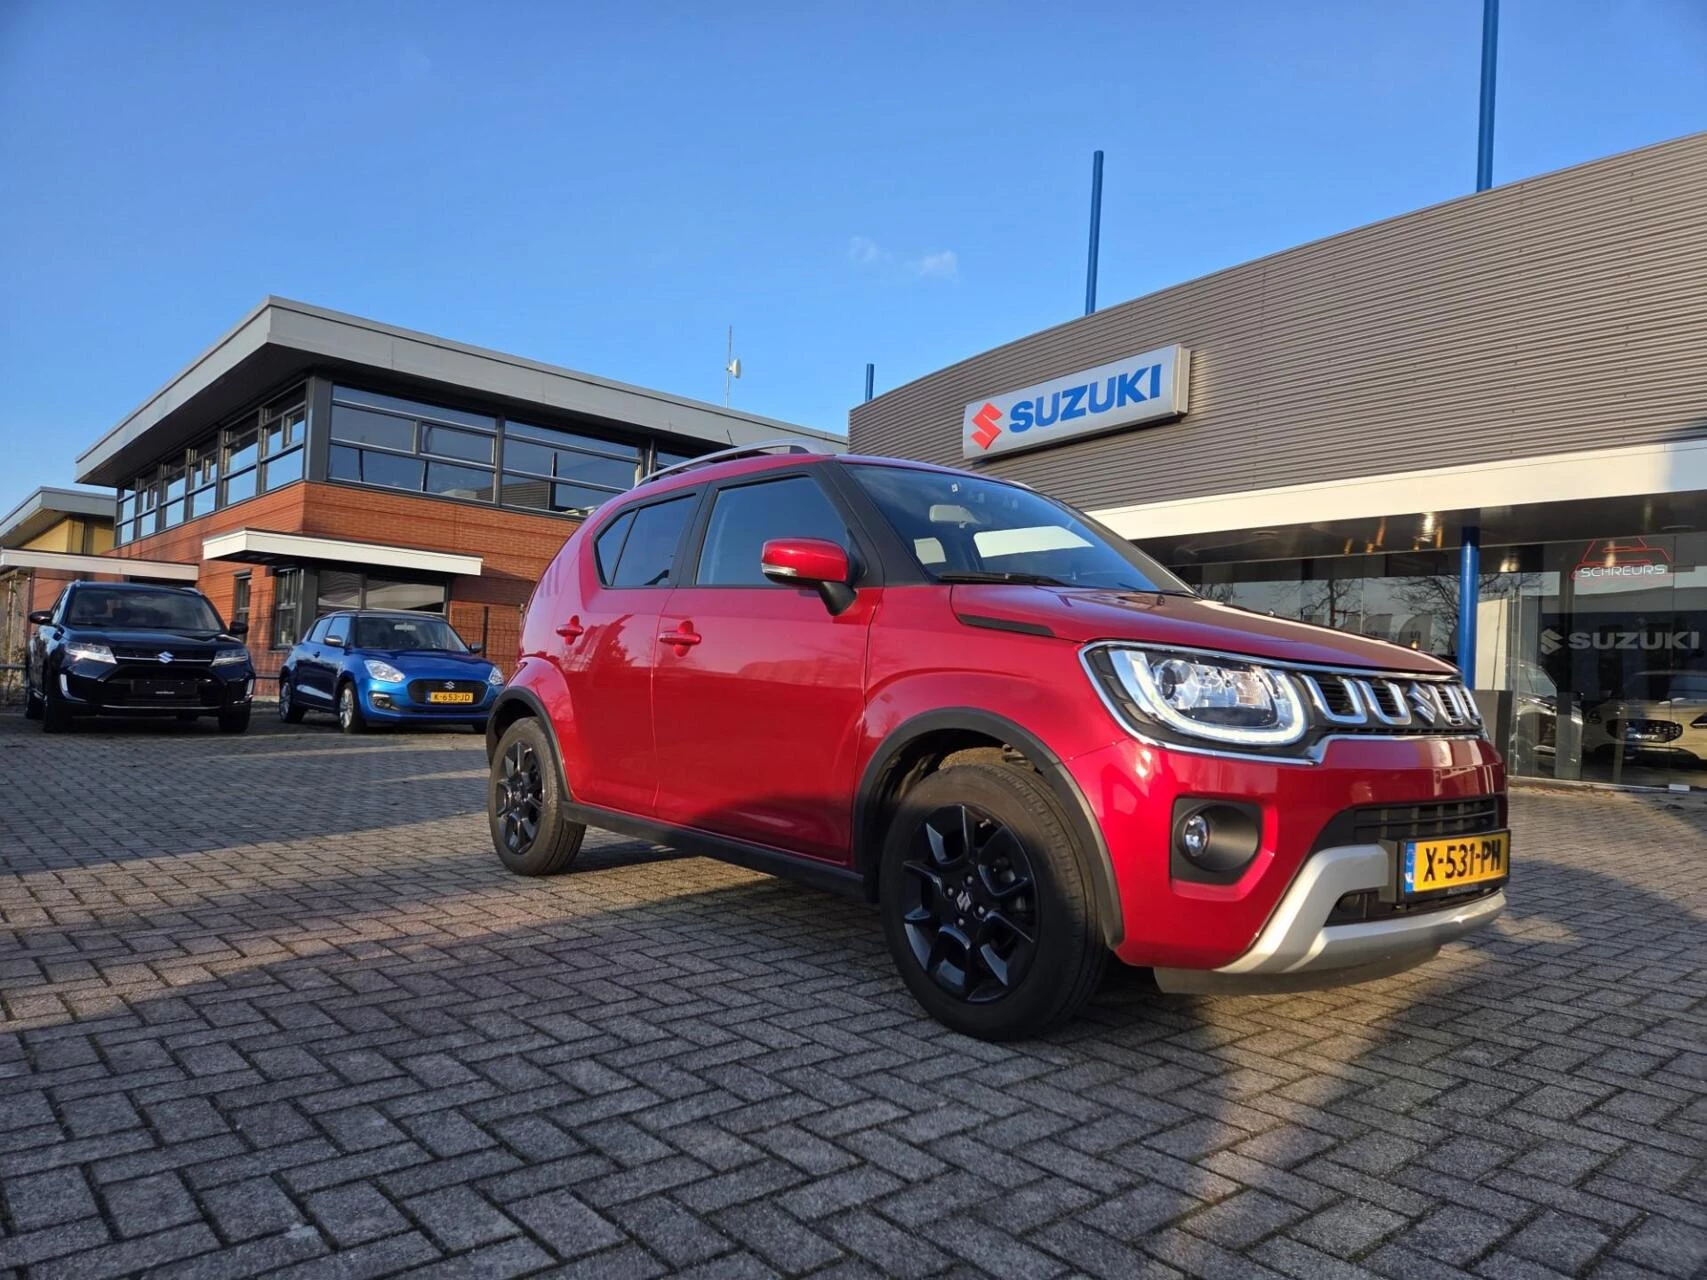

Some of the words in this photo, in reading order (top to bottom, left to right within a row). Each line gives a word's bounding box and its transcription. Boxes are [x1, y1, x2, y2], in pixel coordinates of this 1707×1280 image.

[1009, 364, 1162, 433] SUZUKI
[1580, 564, 1666, 578] SCHREURS
[1568, 631, 1700, 649] SUZUKI
[1423, 839, 1502, 882] X-531-PN
